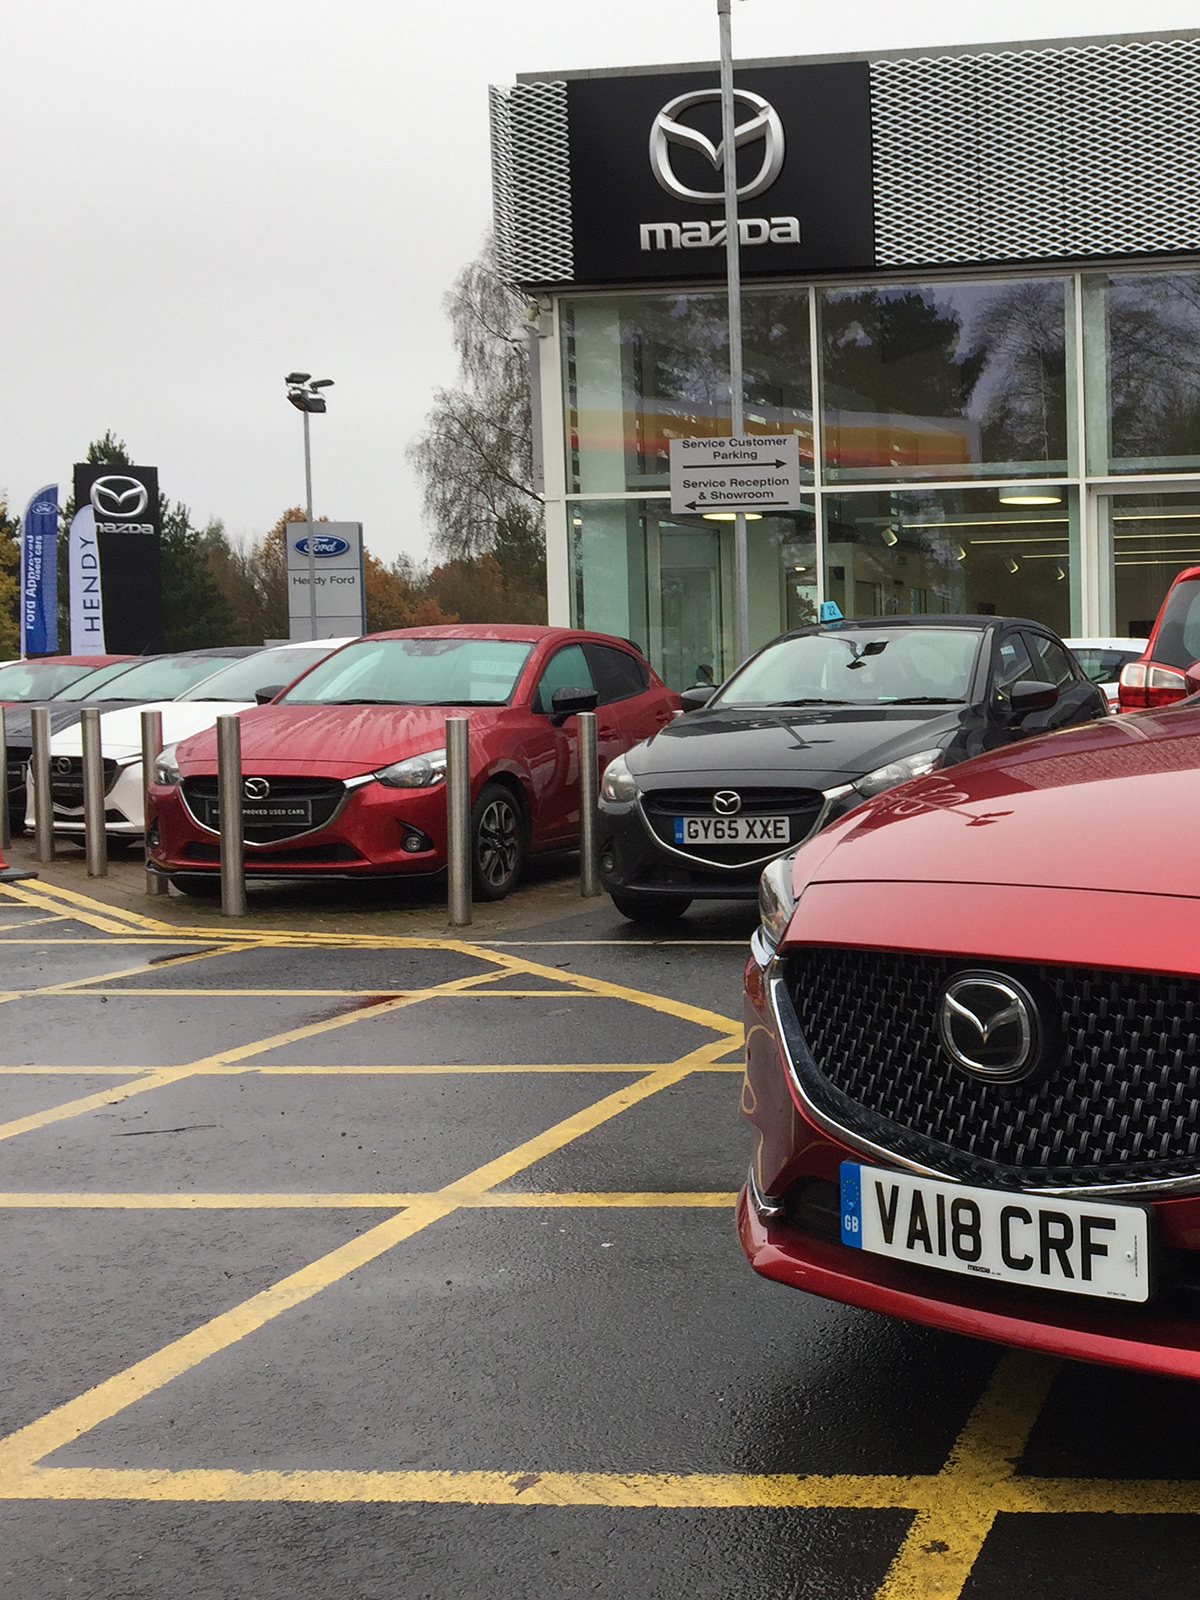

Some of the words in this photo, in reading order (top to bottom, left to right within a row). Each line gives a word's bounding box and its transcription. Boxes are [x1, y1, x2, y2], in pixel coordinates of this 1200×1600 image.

[639, 216, 801, 251] mazda
[682, 439, 726, 449] Service
[729, 437, 787, 447] Customer
[713, 450, 758, 461] Parking
[682, 479, 727, 489] Service
[730, 477, 790, 488] Reception
[698, 491, 706, 500] &
[710, 490, 774, 500] Showroom
[303, 537, 338, 552] Ford
[26, 535, 39, 598] Approved
[79, 536, 101, 632] HENDY
[293, 576, 327, 586] Hedy
[330, 576, 355, 584] Ford
[26, 600, 36, 630] Ford
[687, 819, 739, 840] GY65
[745, 819, 786, 839] XXE
[844, 1214, 859, 1233] GB
[874, 1180, 982, 1262] VA18
[999, 1205, 1116, 1281] CRF
